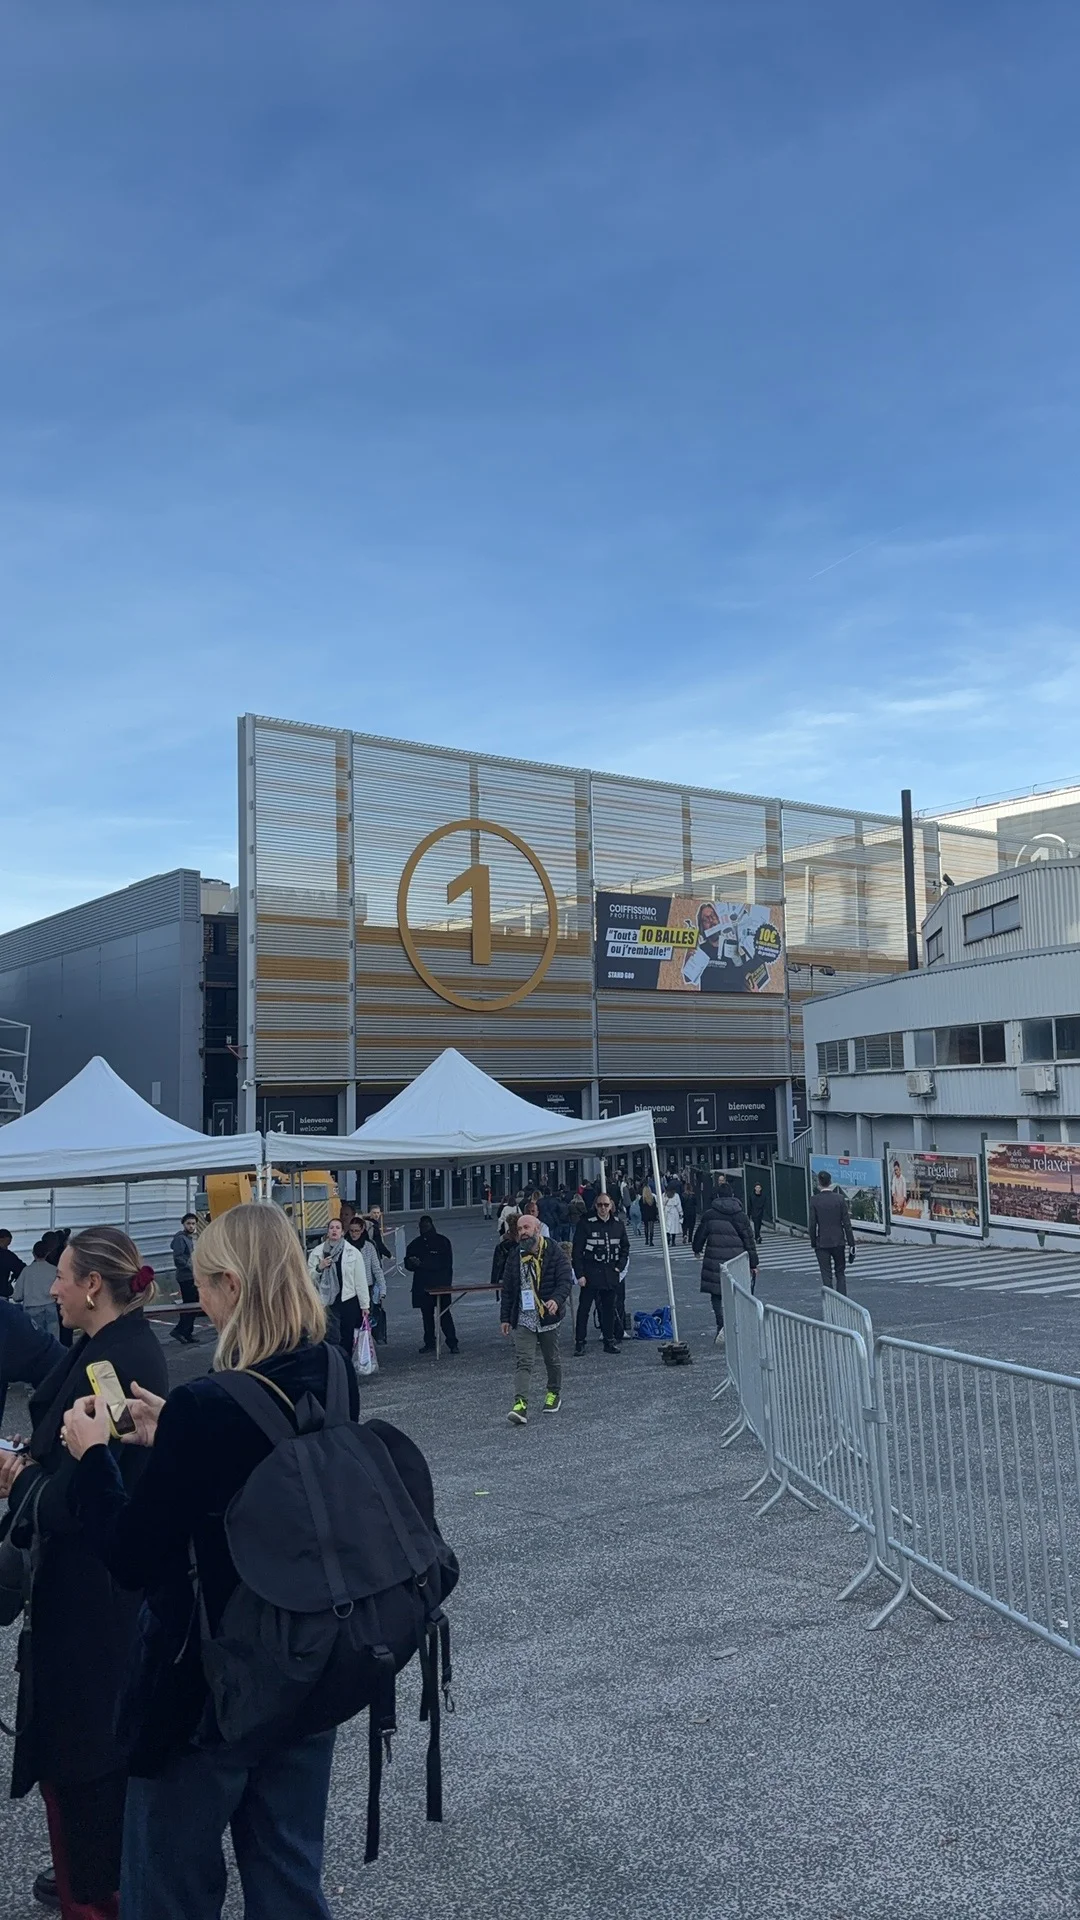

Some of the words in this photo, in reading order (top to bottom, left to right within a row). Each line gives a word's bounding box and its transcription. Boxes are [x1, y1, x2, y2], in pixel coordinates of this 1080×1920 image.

[447, 864, 491, 965] 1
[609, 904, 657, 915] COIFFISSIMO
[610, 913, 658, 921] PROFESSIONAL
[641, 929, 653, 942] 10
[655, 931, 695, 945] BALLES
[759, 928, 777, 943] 10€
[608, 971, 624, 979] STAND
[728, 1102, 765, 1110] bienvenue
[697, 1106, 708, 1124] 1
[728, 1113, 759, 1121] welcome
[277, 1120, 288, 1134] 1
[1033, 1154, 1072, 1172] relaxer
[927, 1162, 958, 1180] régaler
